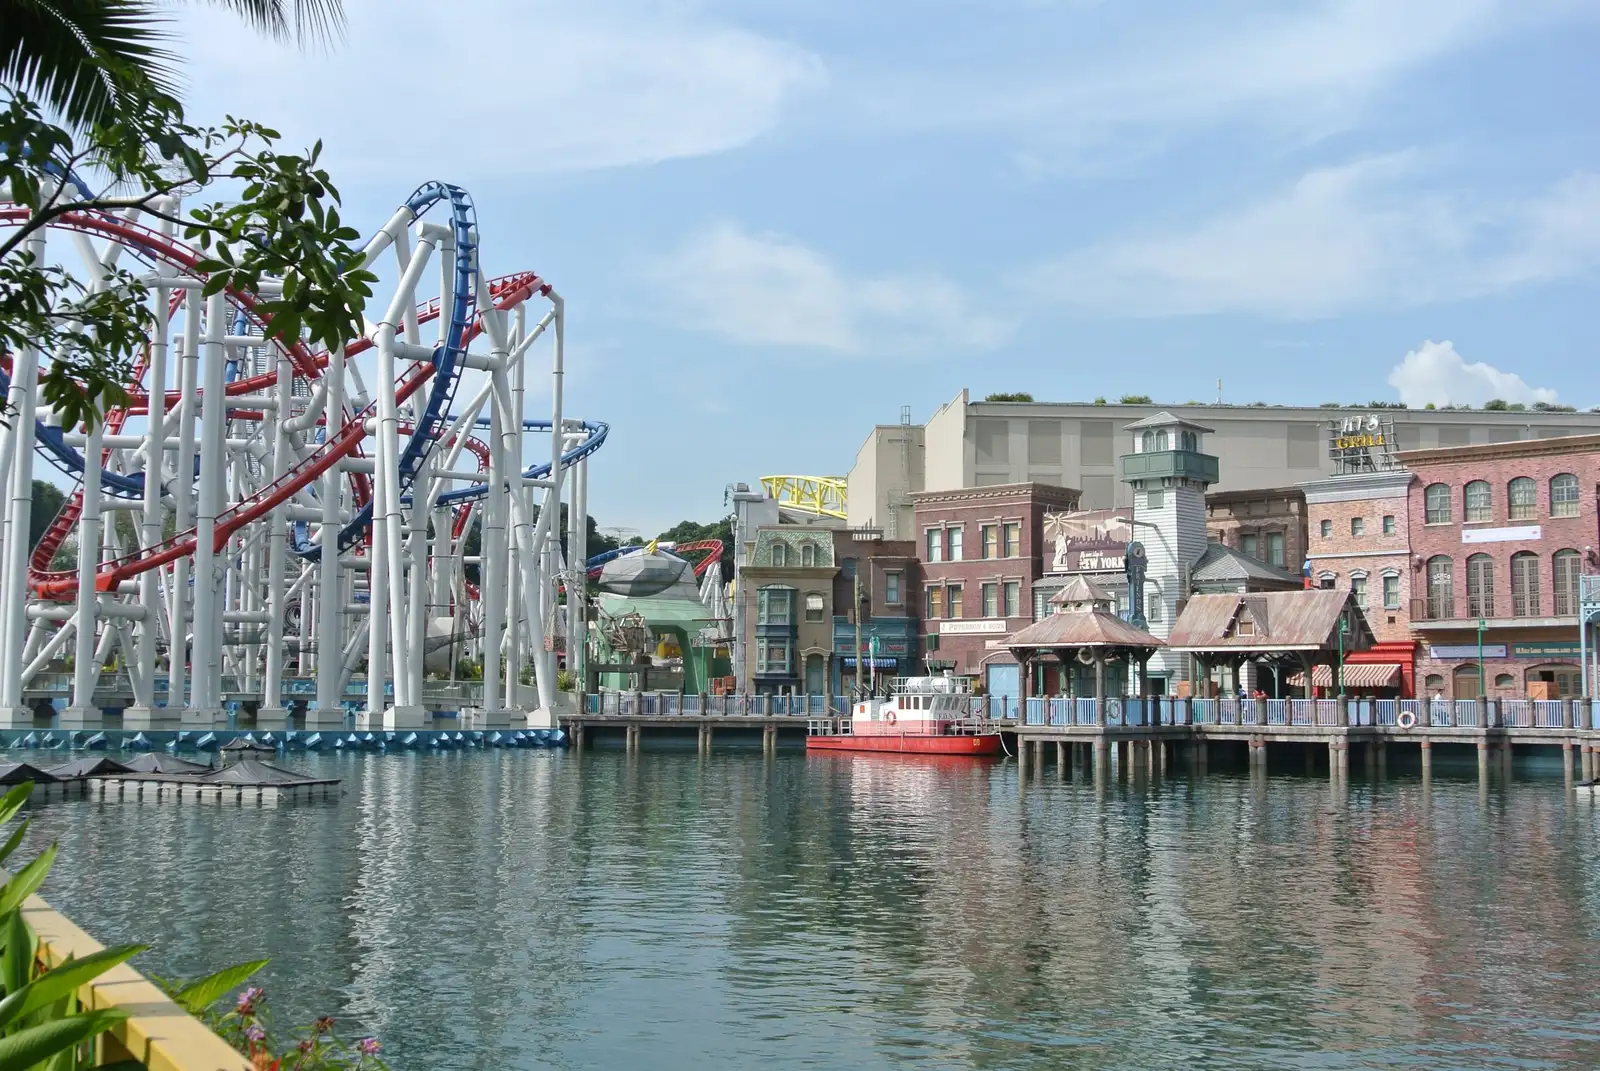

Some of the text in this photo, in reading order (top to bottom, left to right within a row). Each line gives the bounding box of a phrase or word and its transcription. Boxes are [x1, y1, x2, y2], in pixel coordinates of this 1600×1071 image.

[1336, 433, 1384, 448] GRILL
[1079, 555, 1126, 570] NEW YORK
